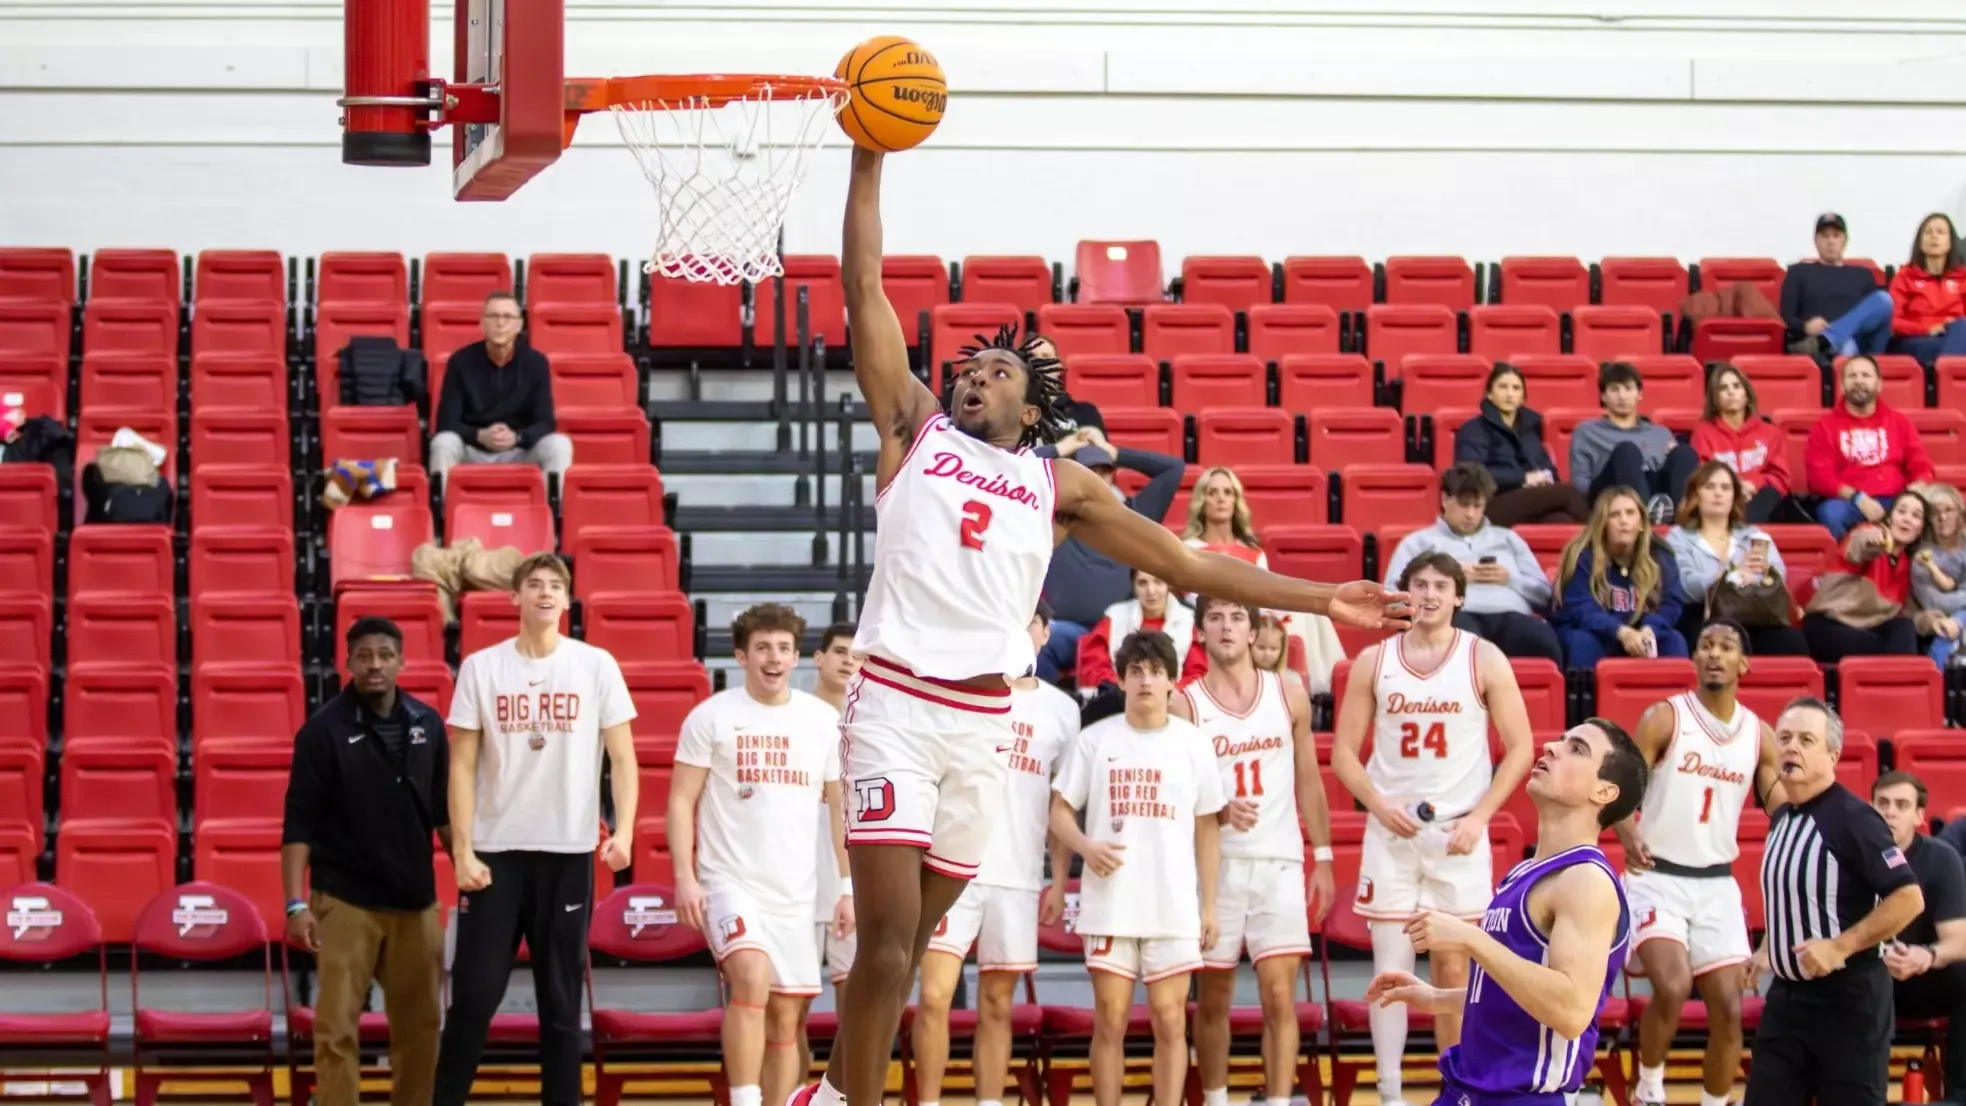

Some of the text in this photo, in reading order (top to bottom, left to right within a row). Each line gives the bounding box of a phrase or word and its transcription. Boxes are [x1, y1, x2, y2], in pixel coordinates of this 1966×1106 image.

[893, 86, 948, 113] Wilson
[923, 452, 1039, 510] Denison
[960, 500, 992, 552] 2
[496, 692, 580, 721] BIG RED
[1386, 692, 1463, 714] Denison
[500, 722, 574, 734] BASKETBALL
[1400, 721, 1448, 759] 24
[736, 735, 790, 750] DENISON
[1211, 735, 1284, 758] Denison
[736, 751, 788, 767] BIG RED
[1677, 751, 1746, 785] Denison
[736, 768, 810, 787] BASKETBALL
[1109, 768, 1162, 784] DENISON
[1233, 759, 1264, 797] 11
[854, 777, 896, 823] D
[1109, 785, 1158, 801] BIG RED
[1699, 786, 1714, 824] 1
[1110, 801, 1176, 821] BASKETBAL
